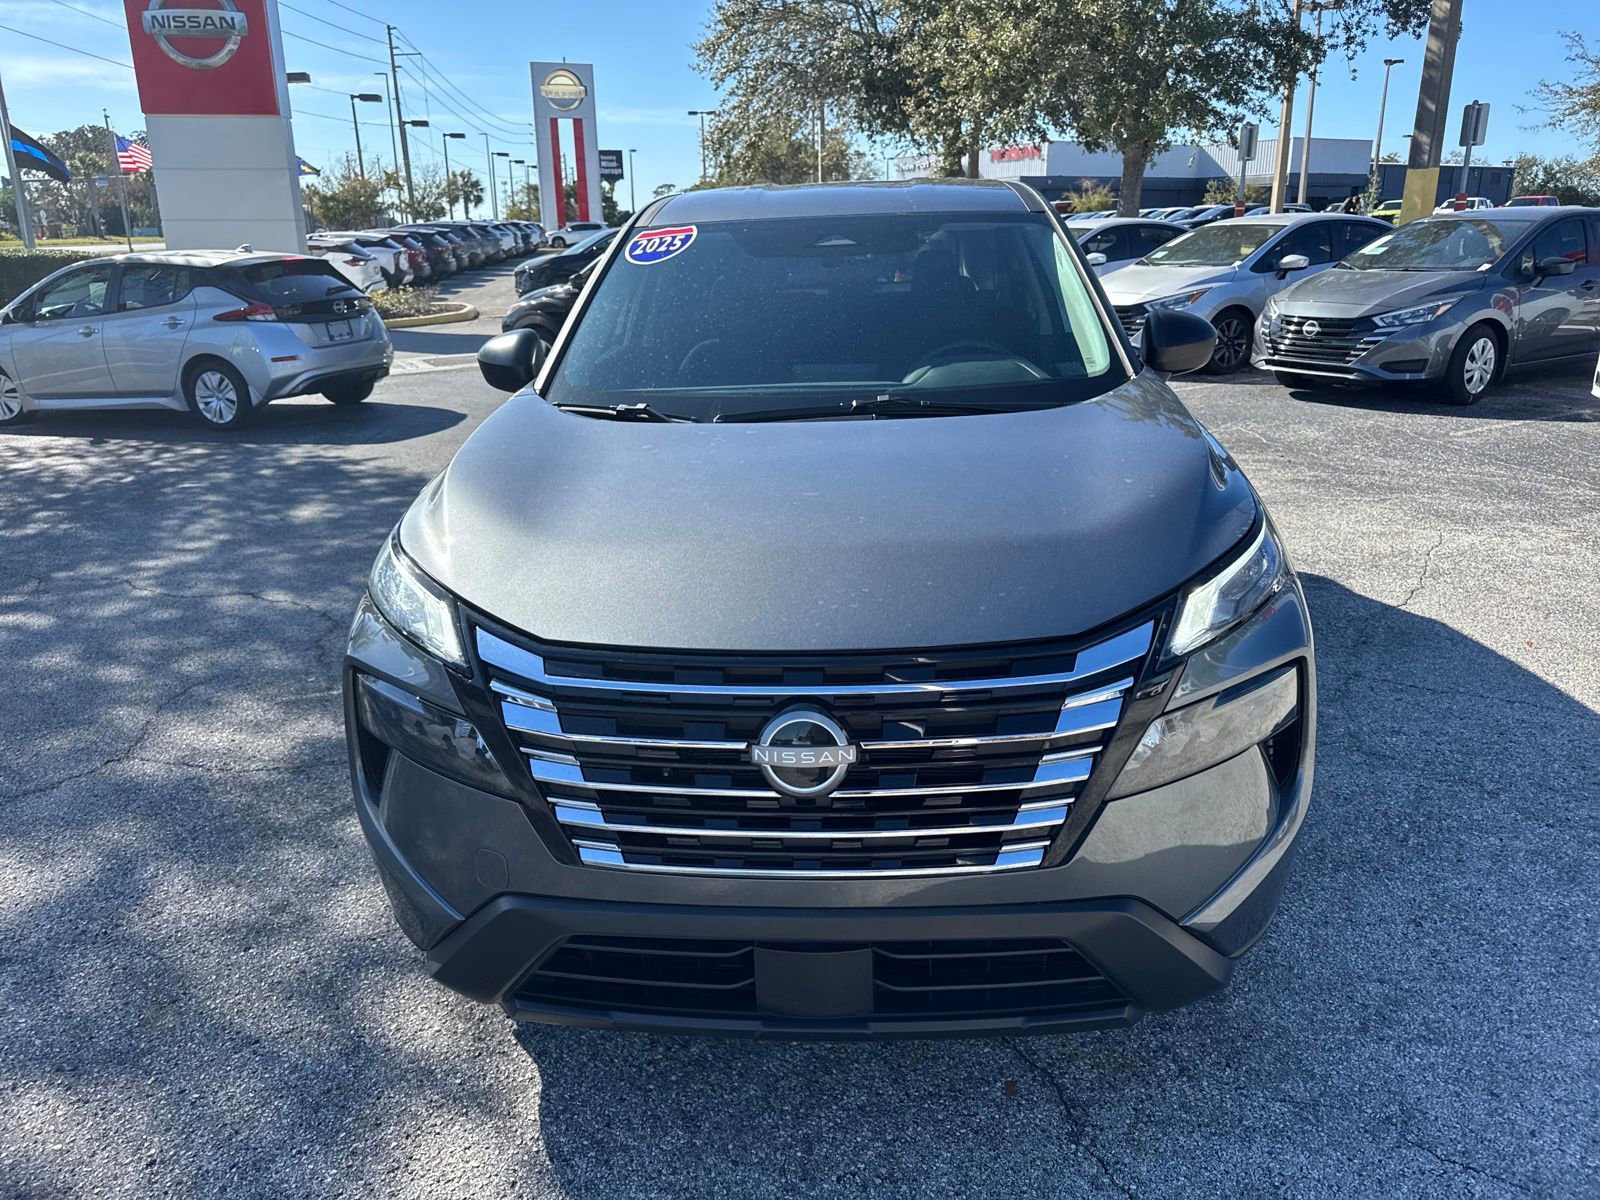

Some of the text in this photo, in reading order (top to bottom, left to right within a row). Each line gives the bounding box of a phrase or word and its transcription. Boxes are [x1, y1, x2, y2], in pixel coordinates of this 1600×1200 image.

[150, 14, 236, 31] NISSAN
[631, 234, 686, 256] 2025
[754, 748, 853, 764] NISSAN
